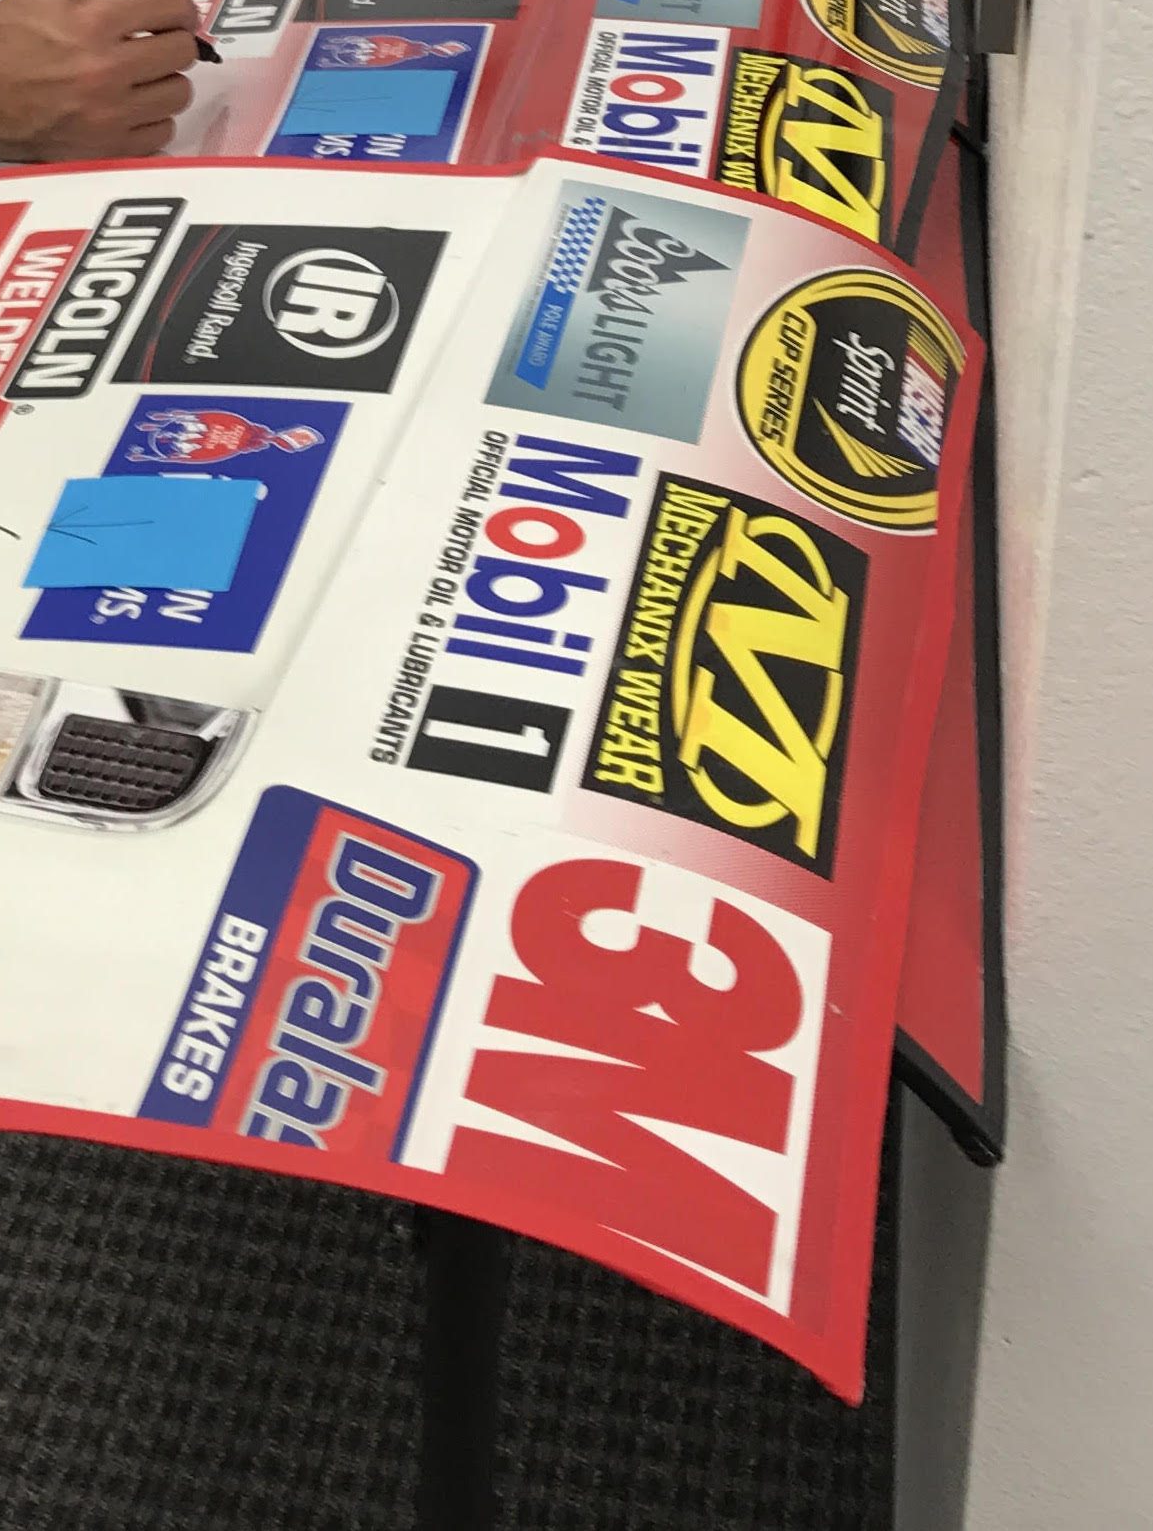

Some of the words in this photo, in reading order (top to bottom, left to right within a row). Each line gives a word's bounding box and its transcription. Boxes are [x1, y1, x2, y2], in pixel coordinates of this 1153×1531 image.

[590, 31, 618, 74] OFFICIAL
[573, 117, 598, 134] OIL
[579, 76, 608, 116] MOTOR
[596, 32, 719, 168] Mobil
[725, 52, 789, 160] MECHANIX
[16, 204, 175, 391] LINCOLN
[208, 239, 269, 313] Ingersoll
[274, 263, 389, 341] IR
[599, 215, 697, 315] Coors
[184, 311, 235, 361] Rand
[538, 306, 564, 332] POLE
[776, 309, 807, 361] CUP
[571, 310, 645, 412] LIGHT
[833, 330, 897, 436] Sprint
[758, 361, 798, 448] SERIES
[462, 429, 510, 503] OFFICIAL
[436, 506, 484, 574] MOTOR
[444, 433, 644, 678] Mobil
[626, 481, 732, 668] MECHANIX
[419, 612, 447, 629] &
[424, 577, 460, 606] OIL
[370, 631, 441, 765] LUBRICANTS
[422, 717, 552, 760] 1
[593, 669, 666, 796] WEAR
[162, 912, 268, 1103] BRAKES
[238, 828, 446, 1152] Durala
